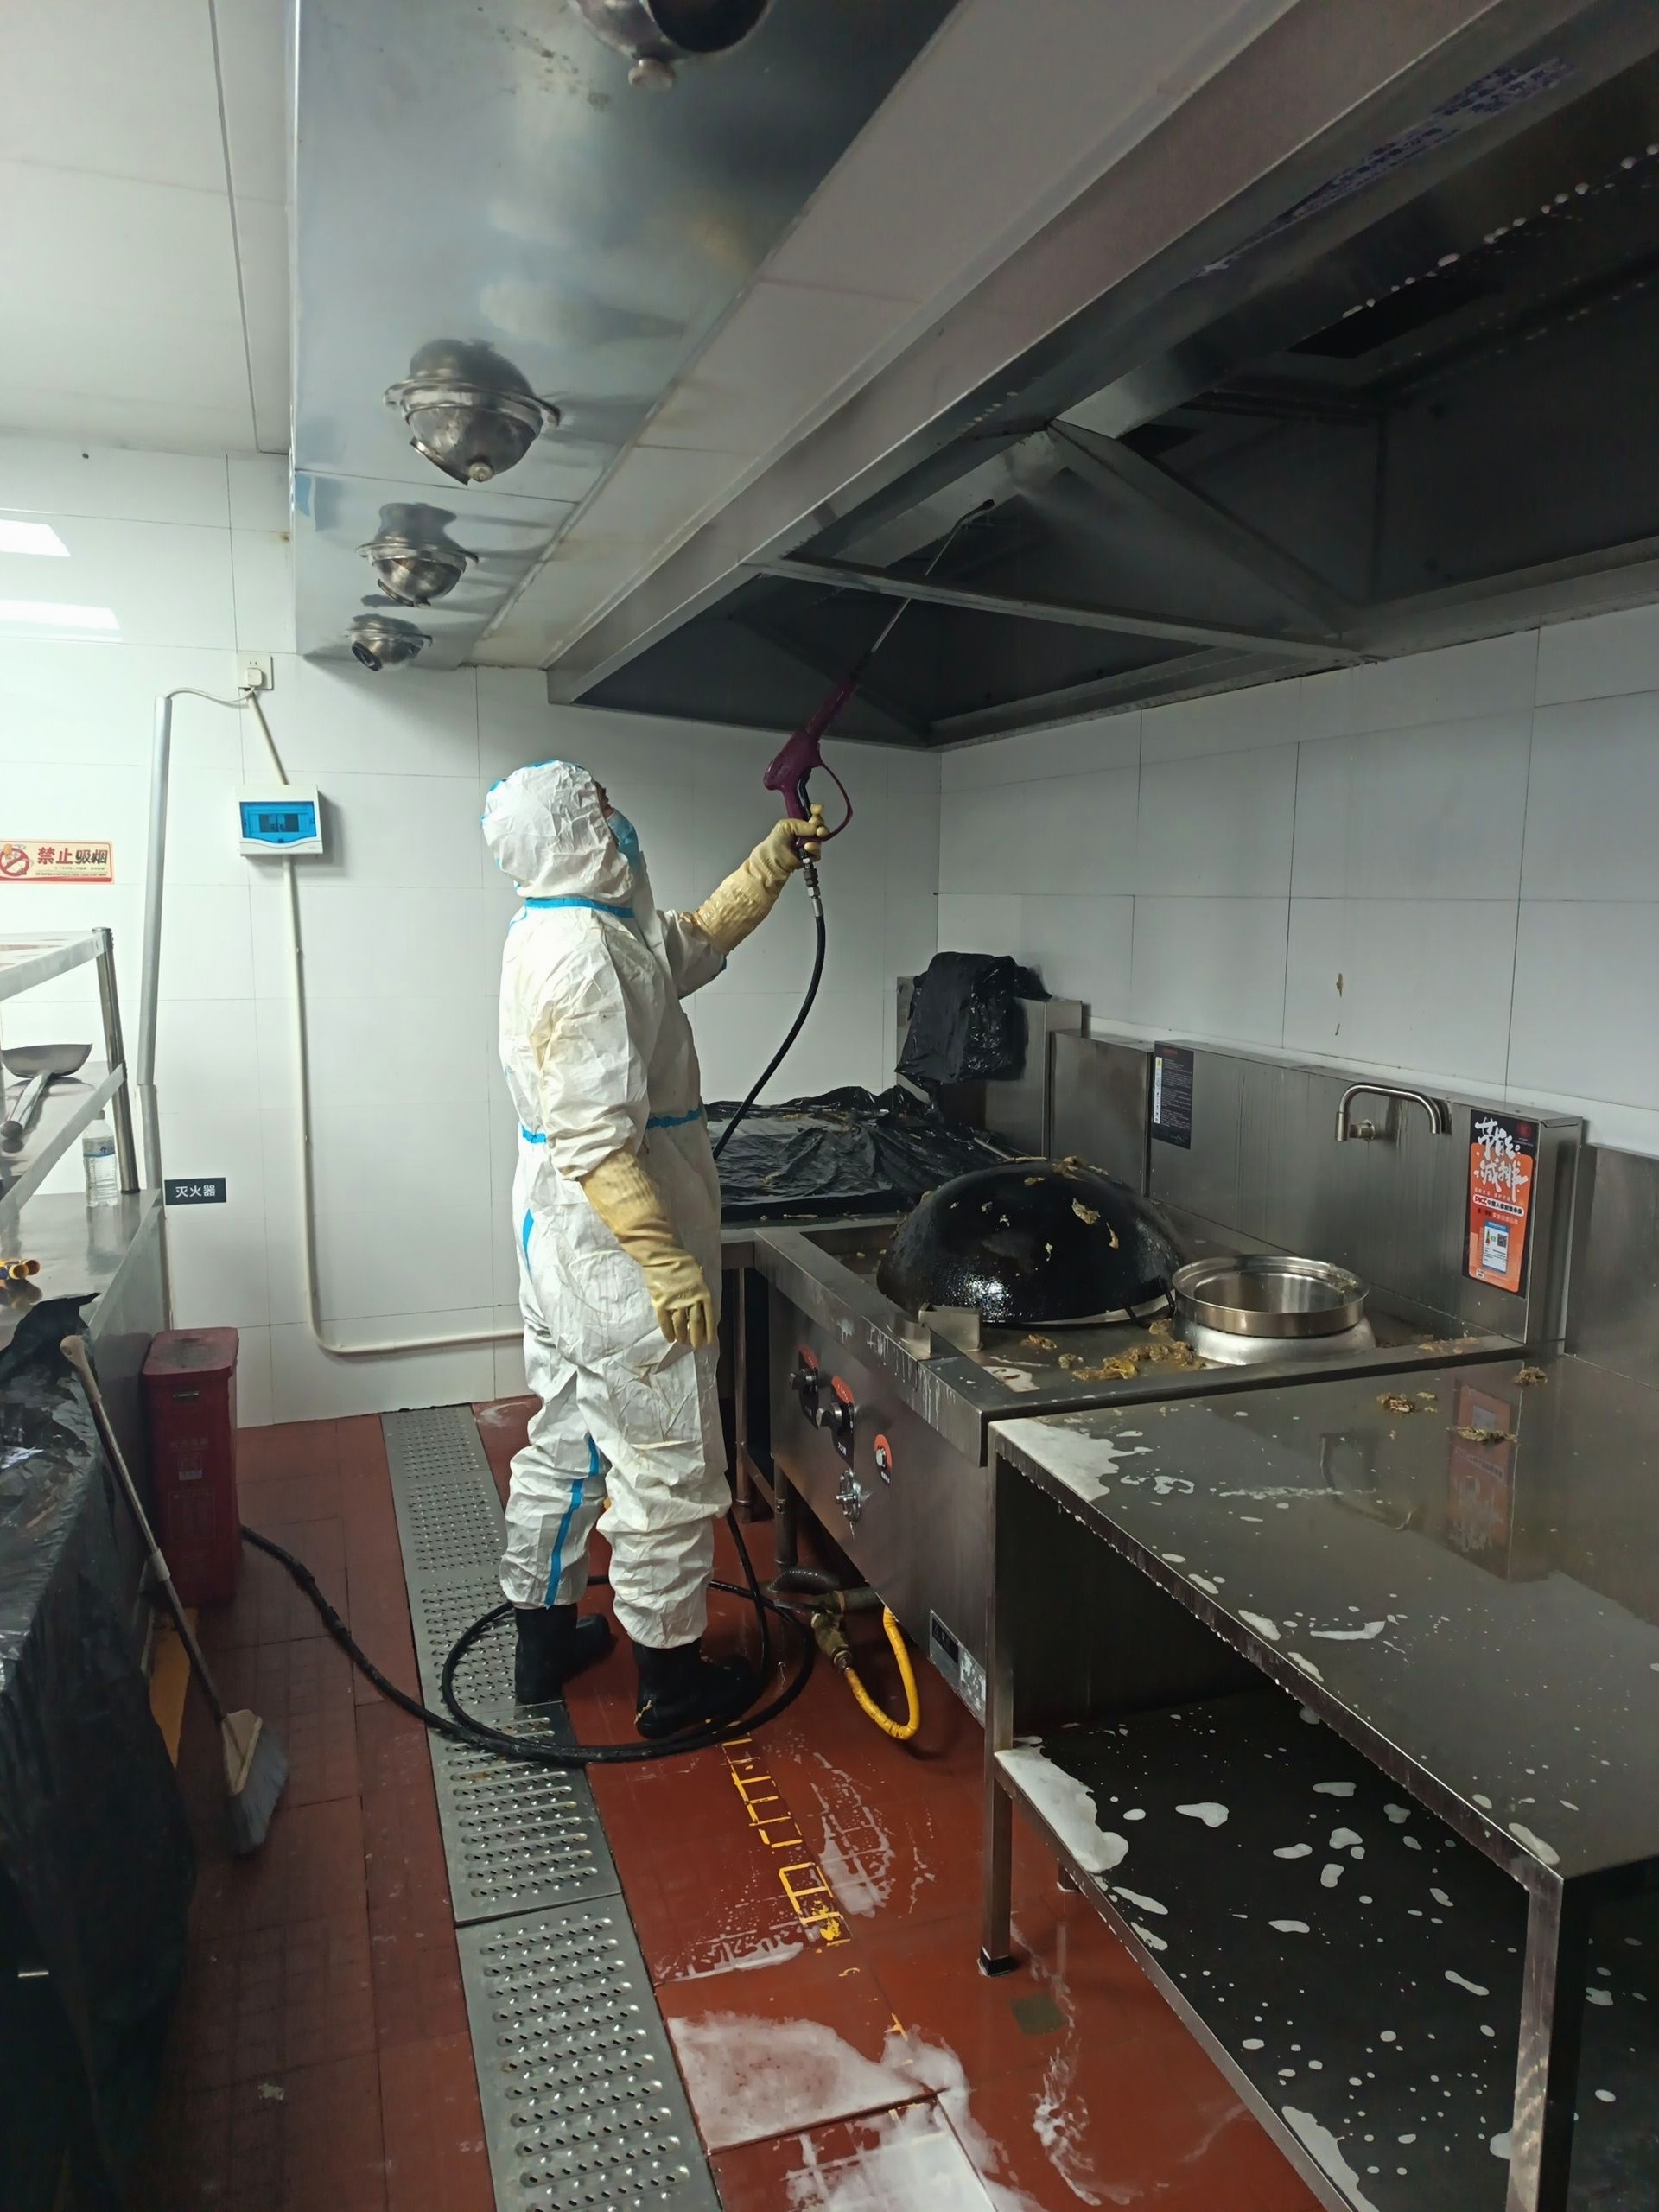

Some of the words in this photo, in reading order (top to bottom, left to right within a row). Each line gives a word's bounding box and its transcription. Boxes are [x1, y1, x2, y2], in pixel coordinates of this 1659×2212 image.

[37, 847, 108, 865] 禁止吸烟
[1474, 1116, 1516, 1160] 节能
[175, 1185, 215, 1198] 灭火器
[1479, 1160, 1529, 1203] 减排
